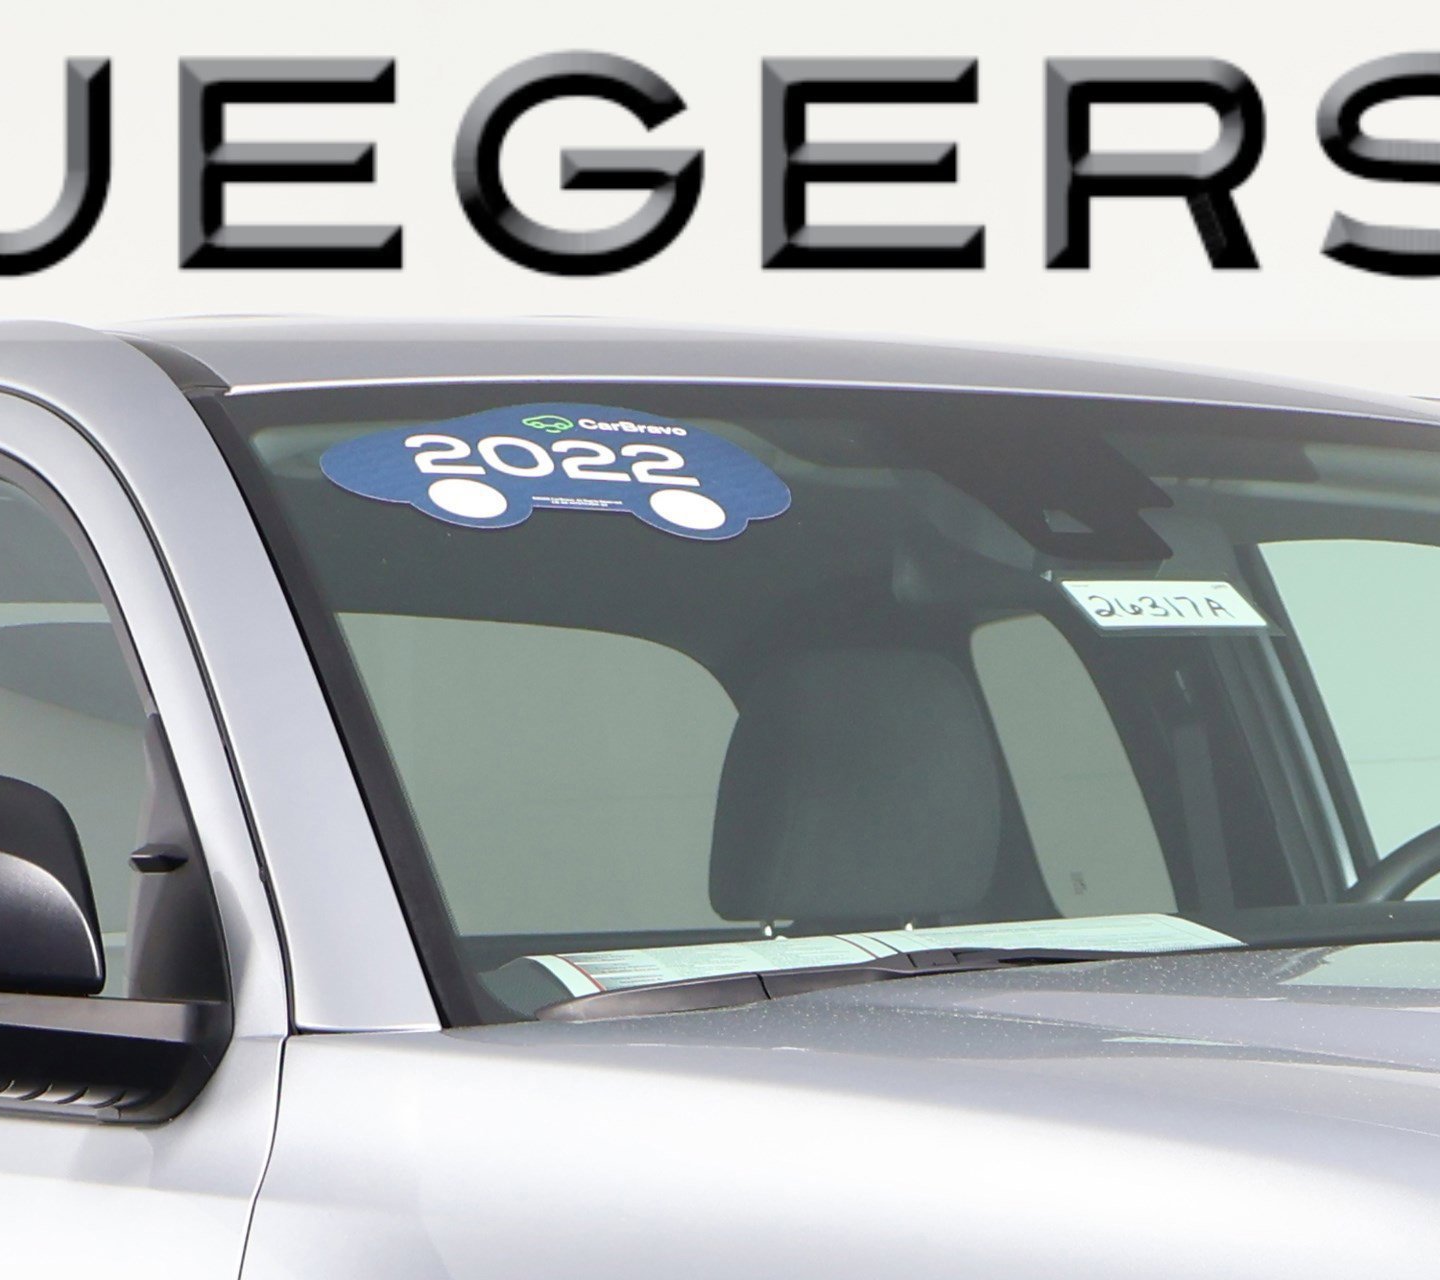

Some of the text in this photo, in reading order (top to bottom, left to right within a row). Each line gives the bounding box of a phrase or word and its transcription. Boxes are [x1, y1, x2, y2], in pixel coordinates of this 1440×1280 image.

[577, 417, 688, 438] CarBravo
[404, 434, 700, 487] 2022
[1087, 594, 1236, 619] 26317A
